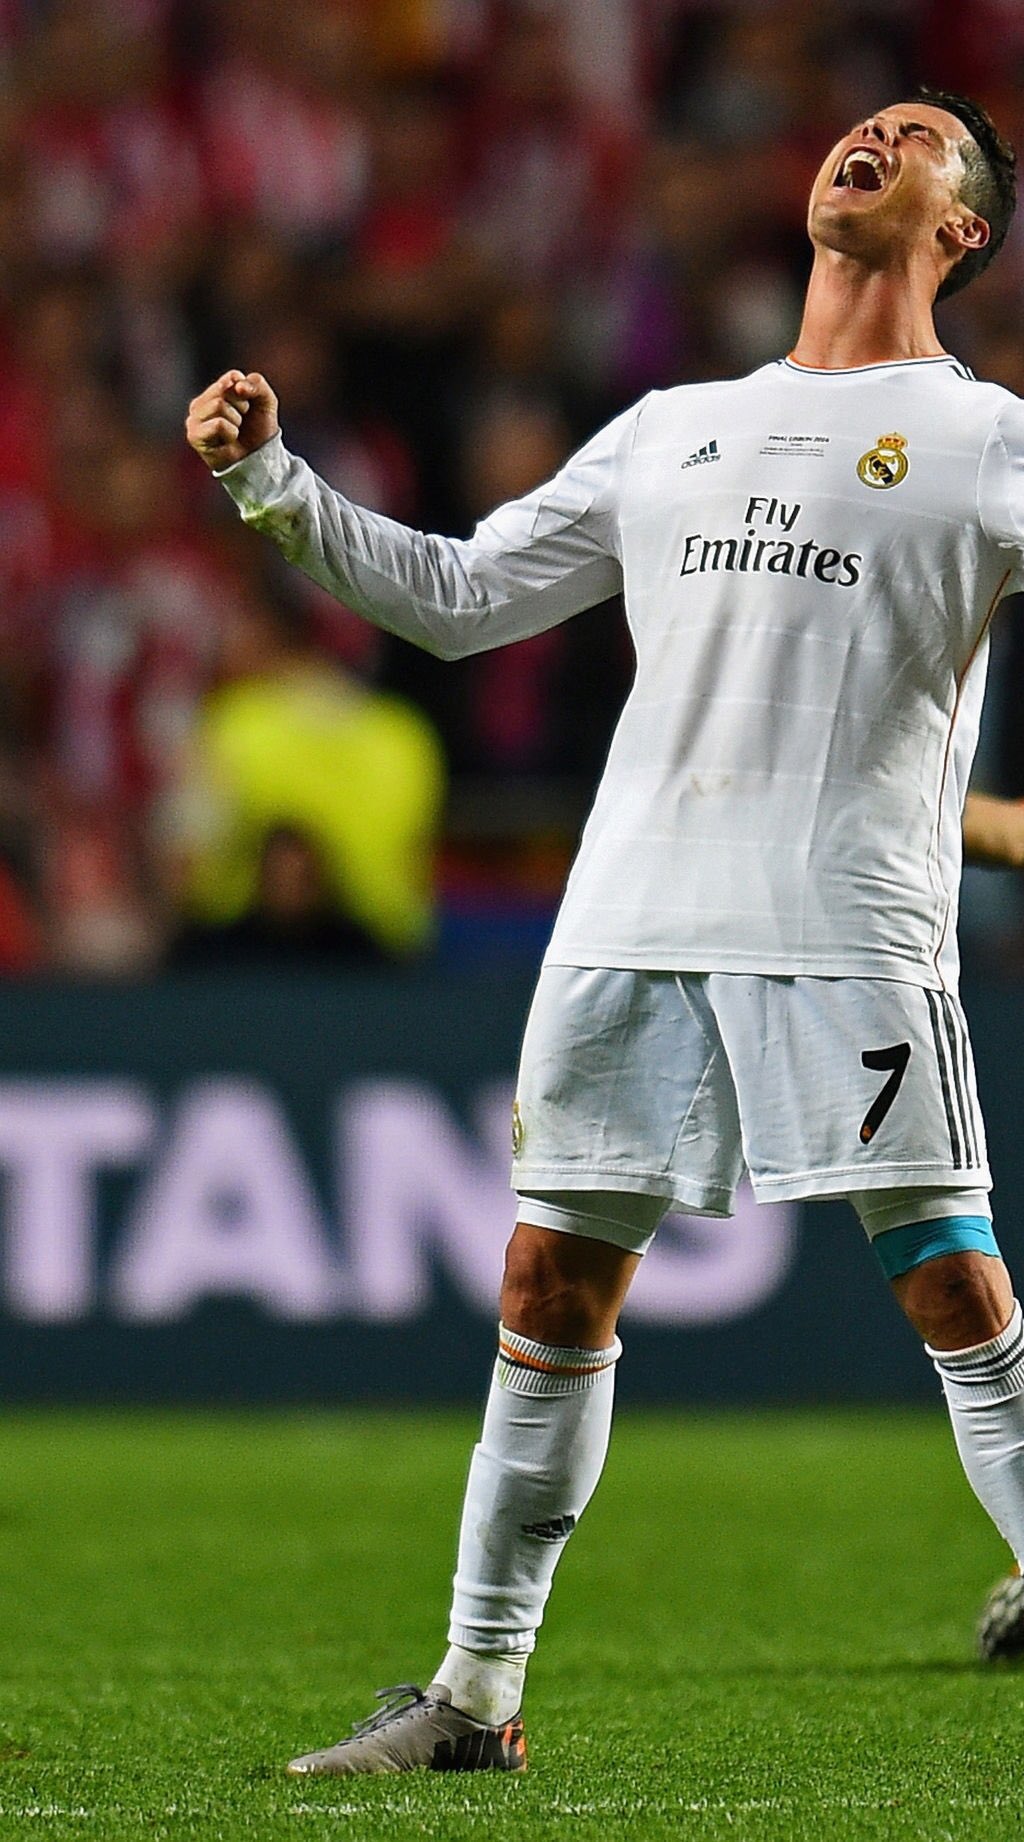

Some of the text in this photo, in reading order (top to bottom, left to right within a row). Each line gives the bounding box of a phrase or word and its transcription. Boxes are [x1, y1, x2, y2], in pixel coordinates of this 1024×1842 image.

[681, 454, 721, 469] adidas
[745, 497, 800, 532] Fly
[680, 529, 862, 587] Emirates
[860, 1042, 911, 1144] 7
